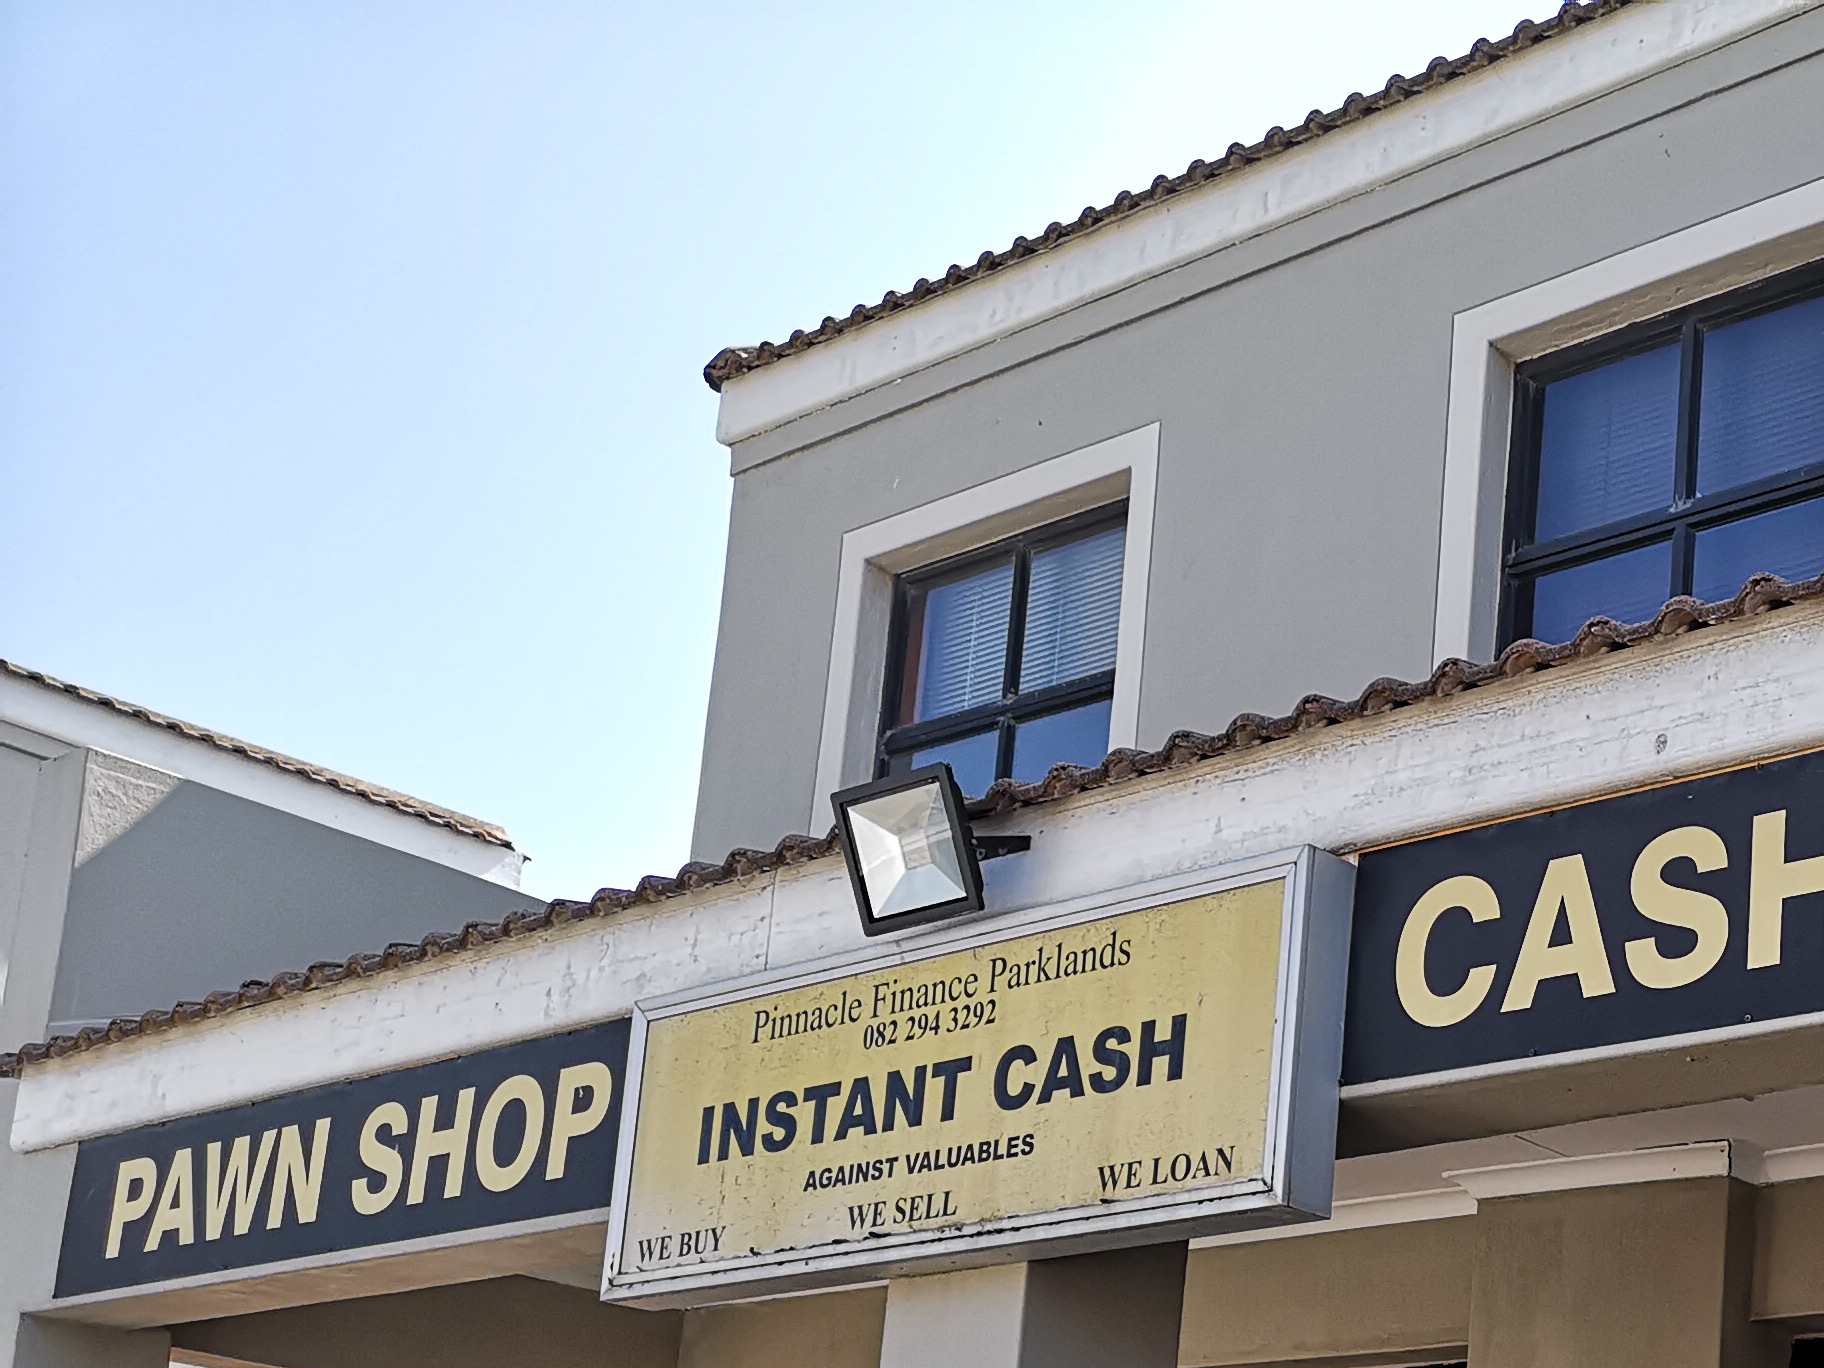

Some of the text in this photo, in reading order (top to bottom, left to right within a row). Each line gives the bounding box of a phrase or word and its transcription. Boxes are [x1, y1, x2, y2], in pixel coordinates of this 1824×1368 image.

[751, 929, 1133, 1045] Pinnacle Finance Parklands
[862, 1000, 997, 1051] 082 294 3292
[697, 1013, 1188, 1166] INSTANT CASH
[105, 1061, 613, 1260] PAWN SHOP
[803, 1133, 1036, 1193] AGAINST VALUABLES
[1098, 1145, 1237, 1194] WE LOAN
[847, 1190, 958, 1232] WE SELL
[637, 1225, 727, 1266] WE BUY
